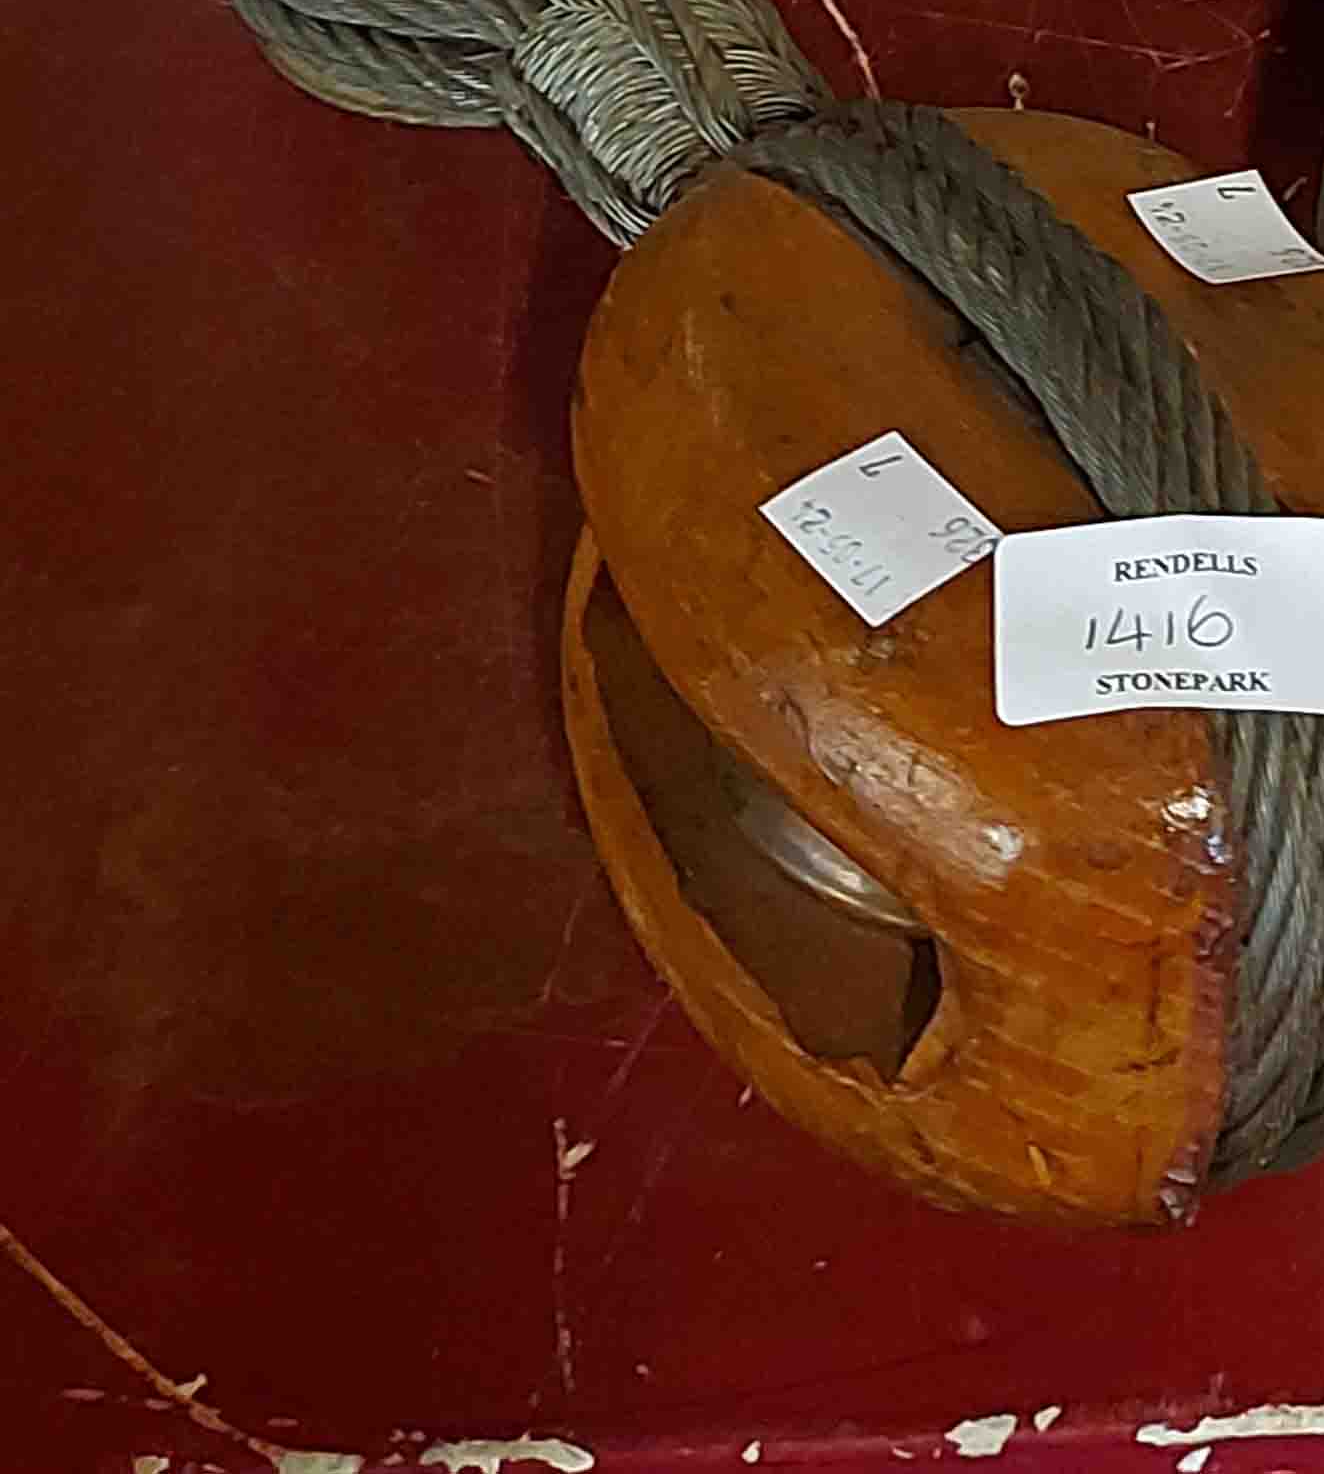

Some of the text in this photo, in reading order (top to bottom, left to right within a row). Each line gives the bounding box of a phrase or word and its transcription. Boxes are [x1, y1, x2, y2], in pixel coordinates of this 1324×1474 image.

[859, 455, 903, 477] 7
[1115, 553, 1258, 582] RENDELLS
[1085, 595, 1234, 652] 1416
[1096, 671, 1272, 696] STONEPARK
